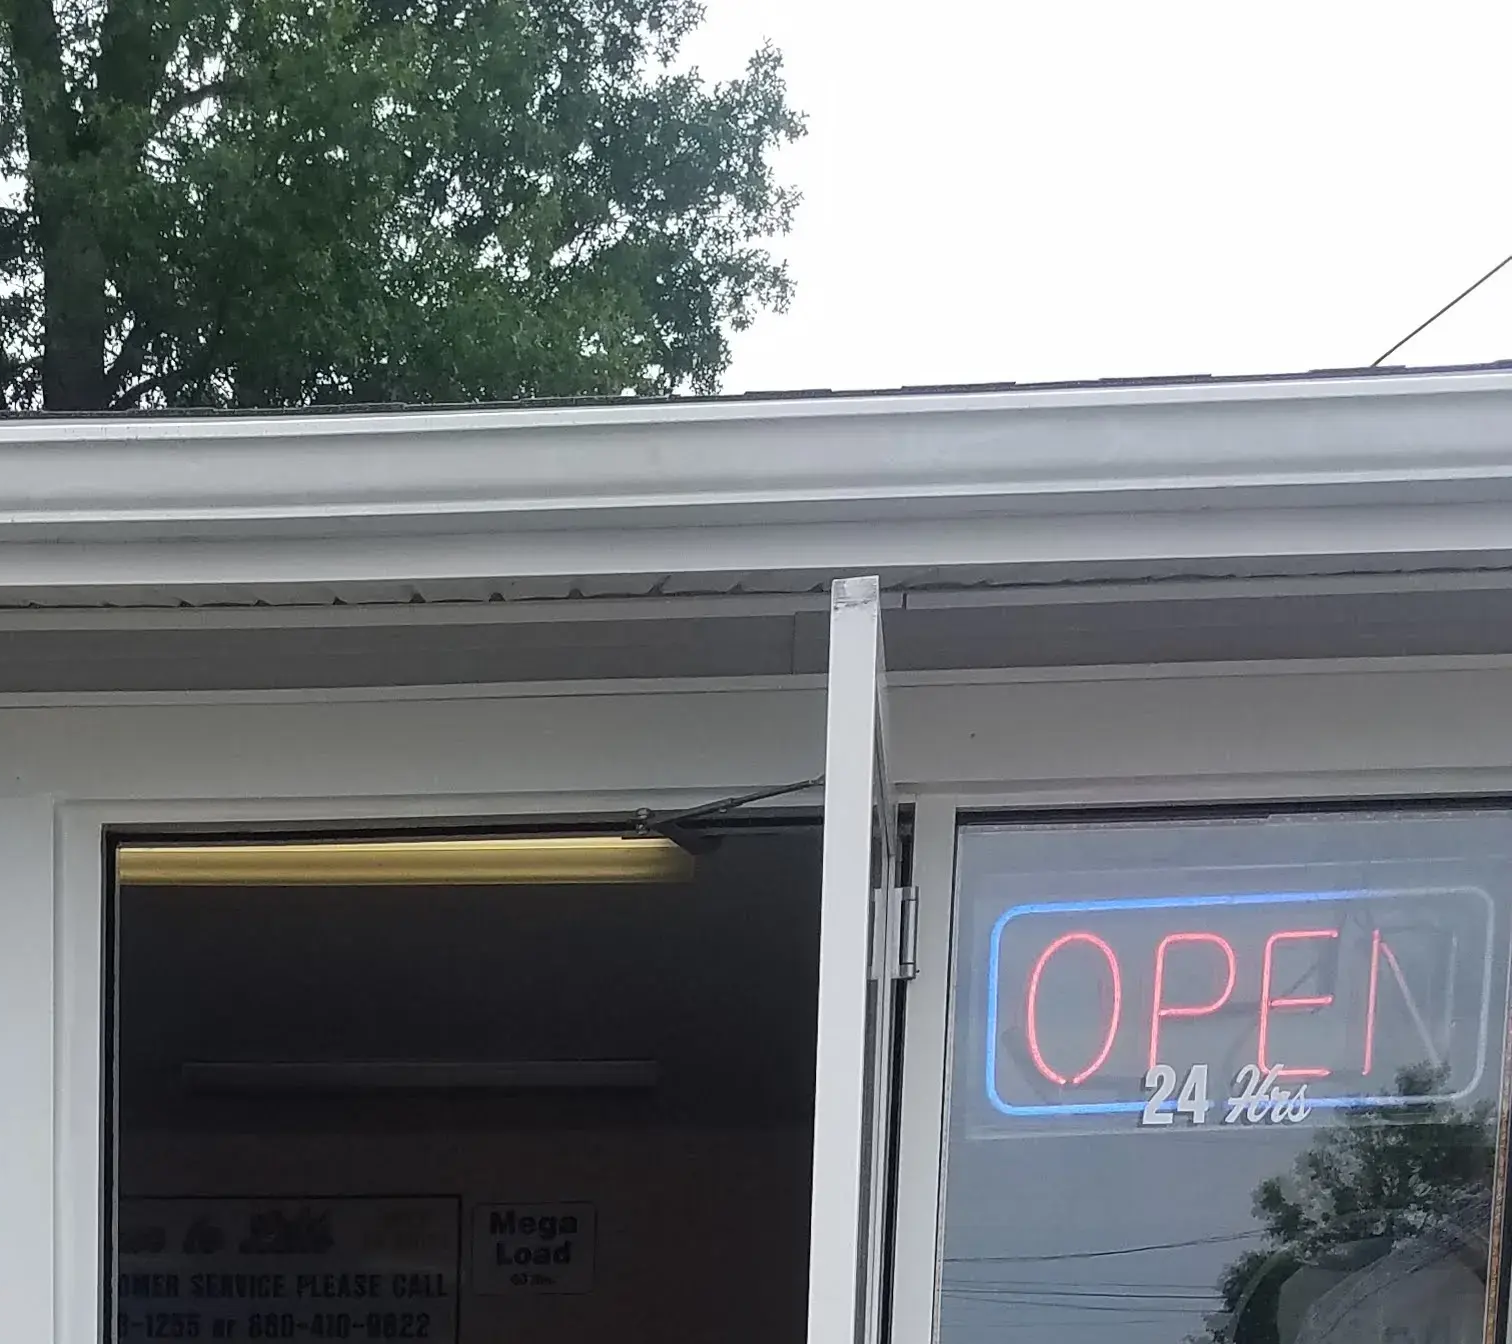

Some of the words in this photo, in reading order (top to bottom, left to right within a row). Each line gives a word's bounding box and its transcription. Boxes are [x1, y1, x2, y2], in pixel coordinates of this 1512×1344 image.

[1026, 929, 1457, 1086] OPEN
[1141, 1063, 1210, 1126] 24
[1225, 1062, 1312, 1125] Hrs
[489, 1209, 578, 1240] Mega
[496, 1240, 572, 1266] Load
[190, 1273, 285, 1299] SERVICE
[295, 1273, 381, 1299] PLEASE
[391, 1272, 449, 1299] CALL
